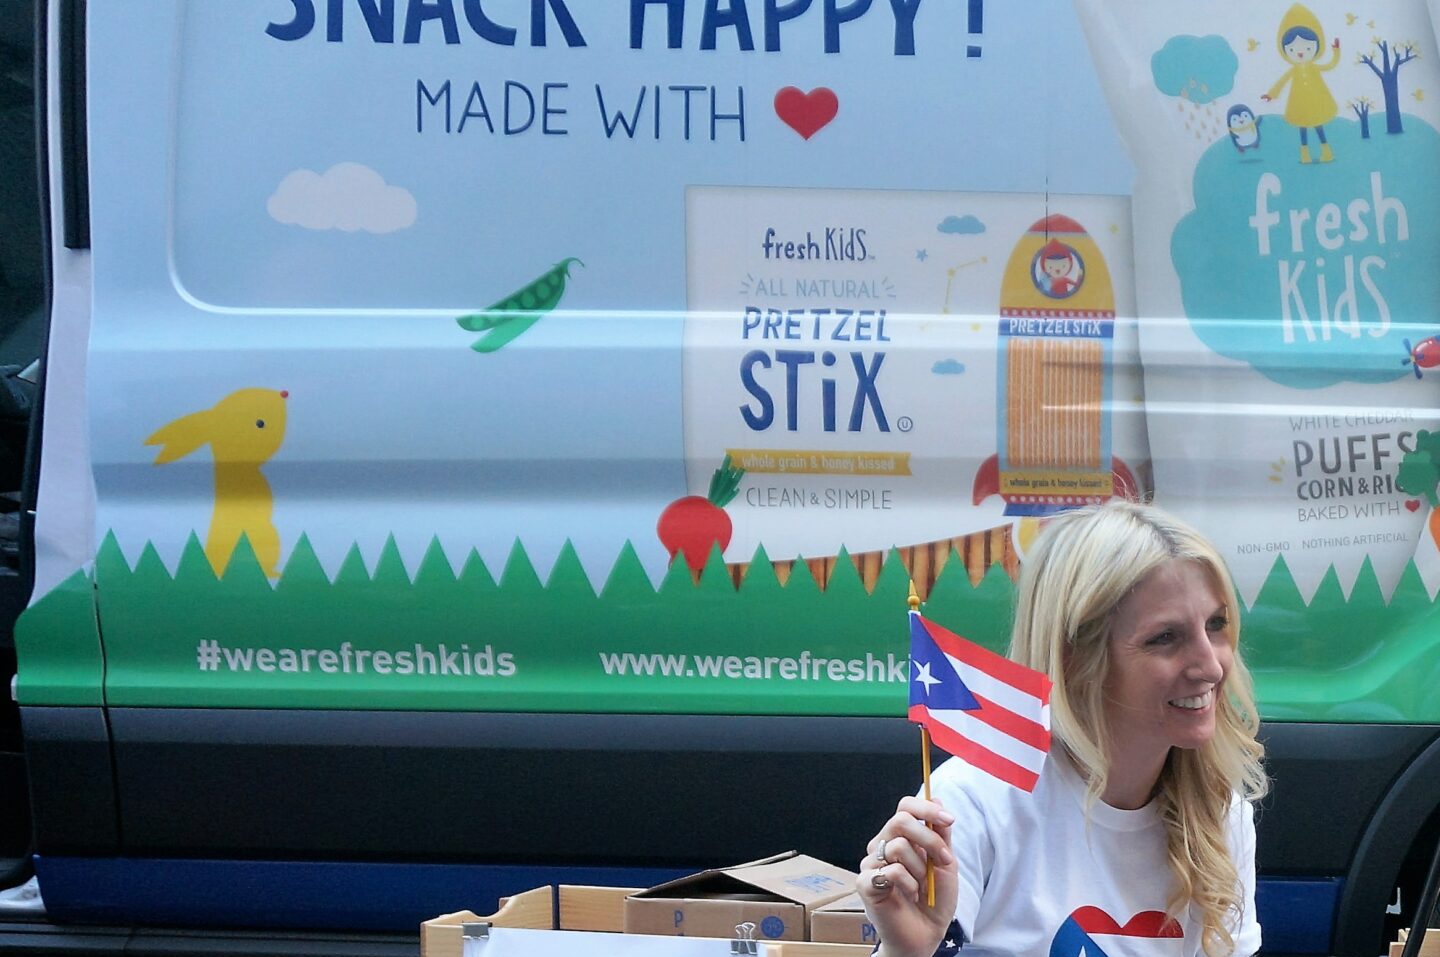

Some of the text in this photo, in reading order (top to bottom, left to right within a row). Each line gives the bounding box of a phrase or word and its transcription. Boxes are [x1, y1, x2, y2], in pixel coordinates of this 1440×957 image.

[266, 0, 587, 47] SNACK
[416, 79, 747, 142] MADE WITH
[1249, 171, 1409, 255] fresh
[762, 227, 820, 260] fresh
[755, 278, 880, 299] ALL NATURAL
[742, 306, 891, 342] PRETZEL
[1009, 319, 1071, 335] PRETZEL
[739, 349, 891, 432] STiX
[1289, 415, 1341, 431] WHITE
[742, 455, 775, 468] whole
[779, 456, 806, 472] grain
[822, 456, 854, 472] honey
[858, 457, 895, 471] kissed
[746, 487, 892, 510] CLEAN & SIMPLE
[1297, 474, 1404, 500] CORN & RI
[1298, 501, 1400, 522] BAKED WITH
[1237, 541, 1290, 554] NON-GMO
[1302, 534, 1350, 550] NOTHING
[1352, 531, 1409, 546] ARTIFICIAL
[197, 639, 517, 677] #wearefreshkids
[599, 650, 911, 684] www.wearefreshk
